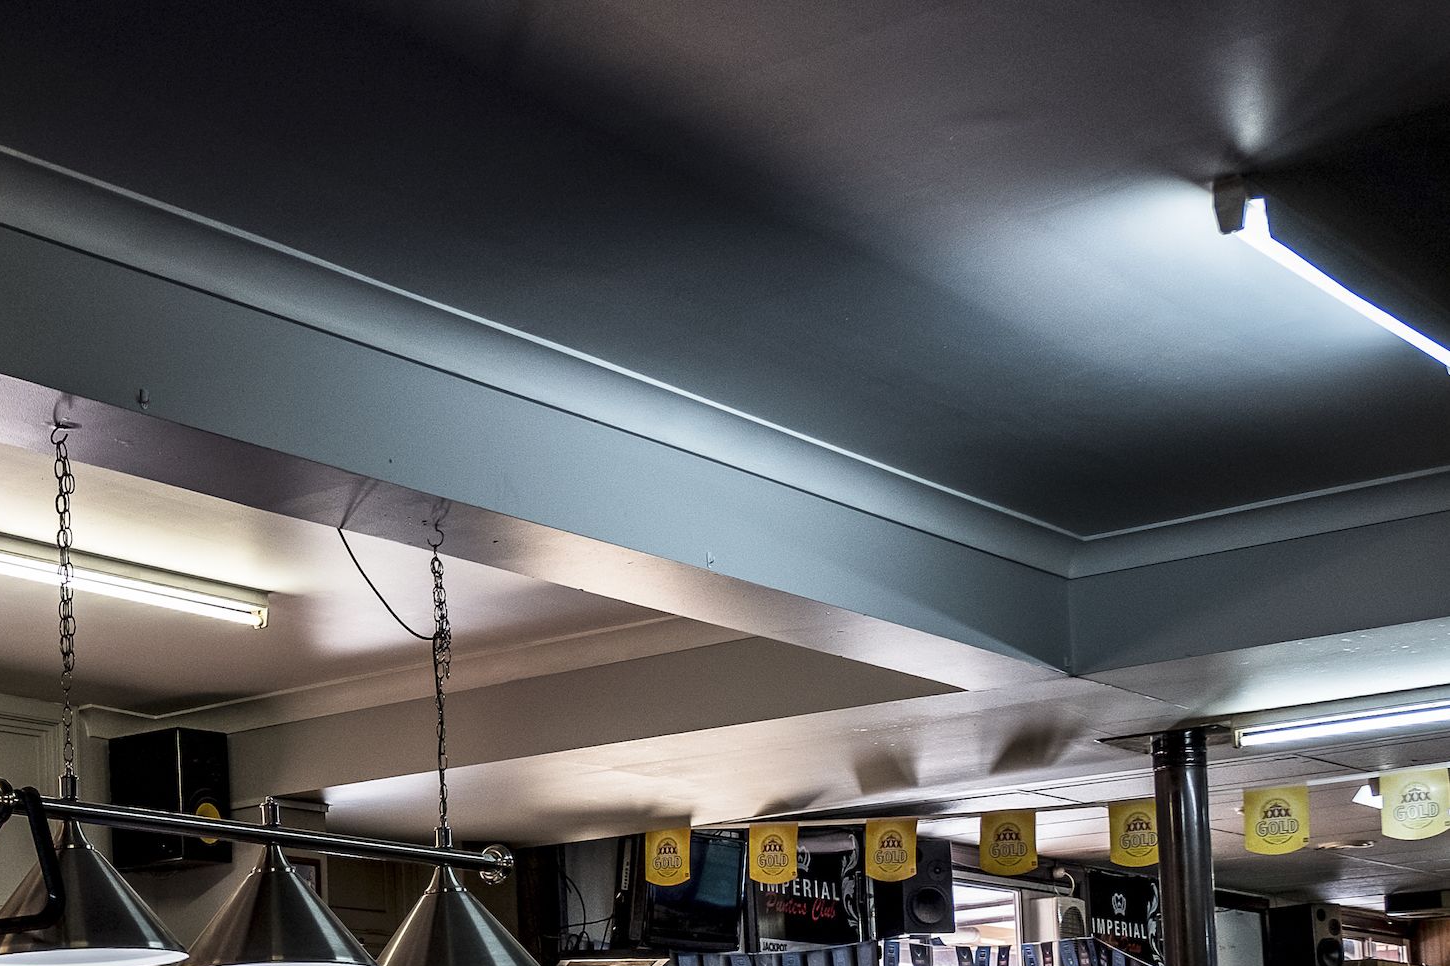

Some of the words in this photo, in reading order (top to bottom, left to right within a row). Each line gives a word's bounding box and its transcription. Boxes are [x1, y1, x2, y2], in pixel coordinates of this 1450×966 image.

[1402, 791, 1431, 803] XXXX
[1263, 808, 1290, 819] XXXX
[1393, 802, 1439, 821] GOLD
[1126, 822, 1151, 832] XXXX
[1256, 818, 1299, 837] GOLD
[996, 832, 1021, 841] XXXX
[1119, 832, 1158, 849] GOLD
[658, 847, 678, 855] XXXX
[763, 844, 783, 853] XXXX
[881, 840, 902, 849] XXXX
[989, 841, 1028, 858] GOLD
[653, 855, 682, 871] GOLD
[757, 853, 788, 868] GOLD
[874, 850, 908, 864] GOLD
[766, 892, 807, 916] Punters
[812, 898, 837, 923] Club
[1092, 917, 1147, 940] IMPERIAL
[762, 940, 788, 951] JACKPOT
